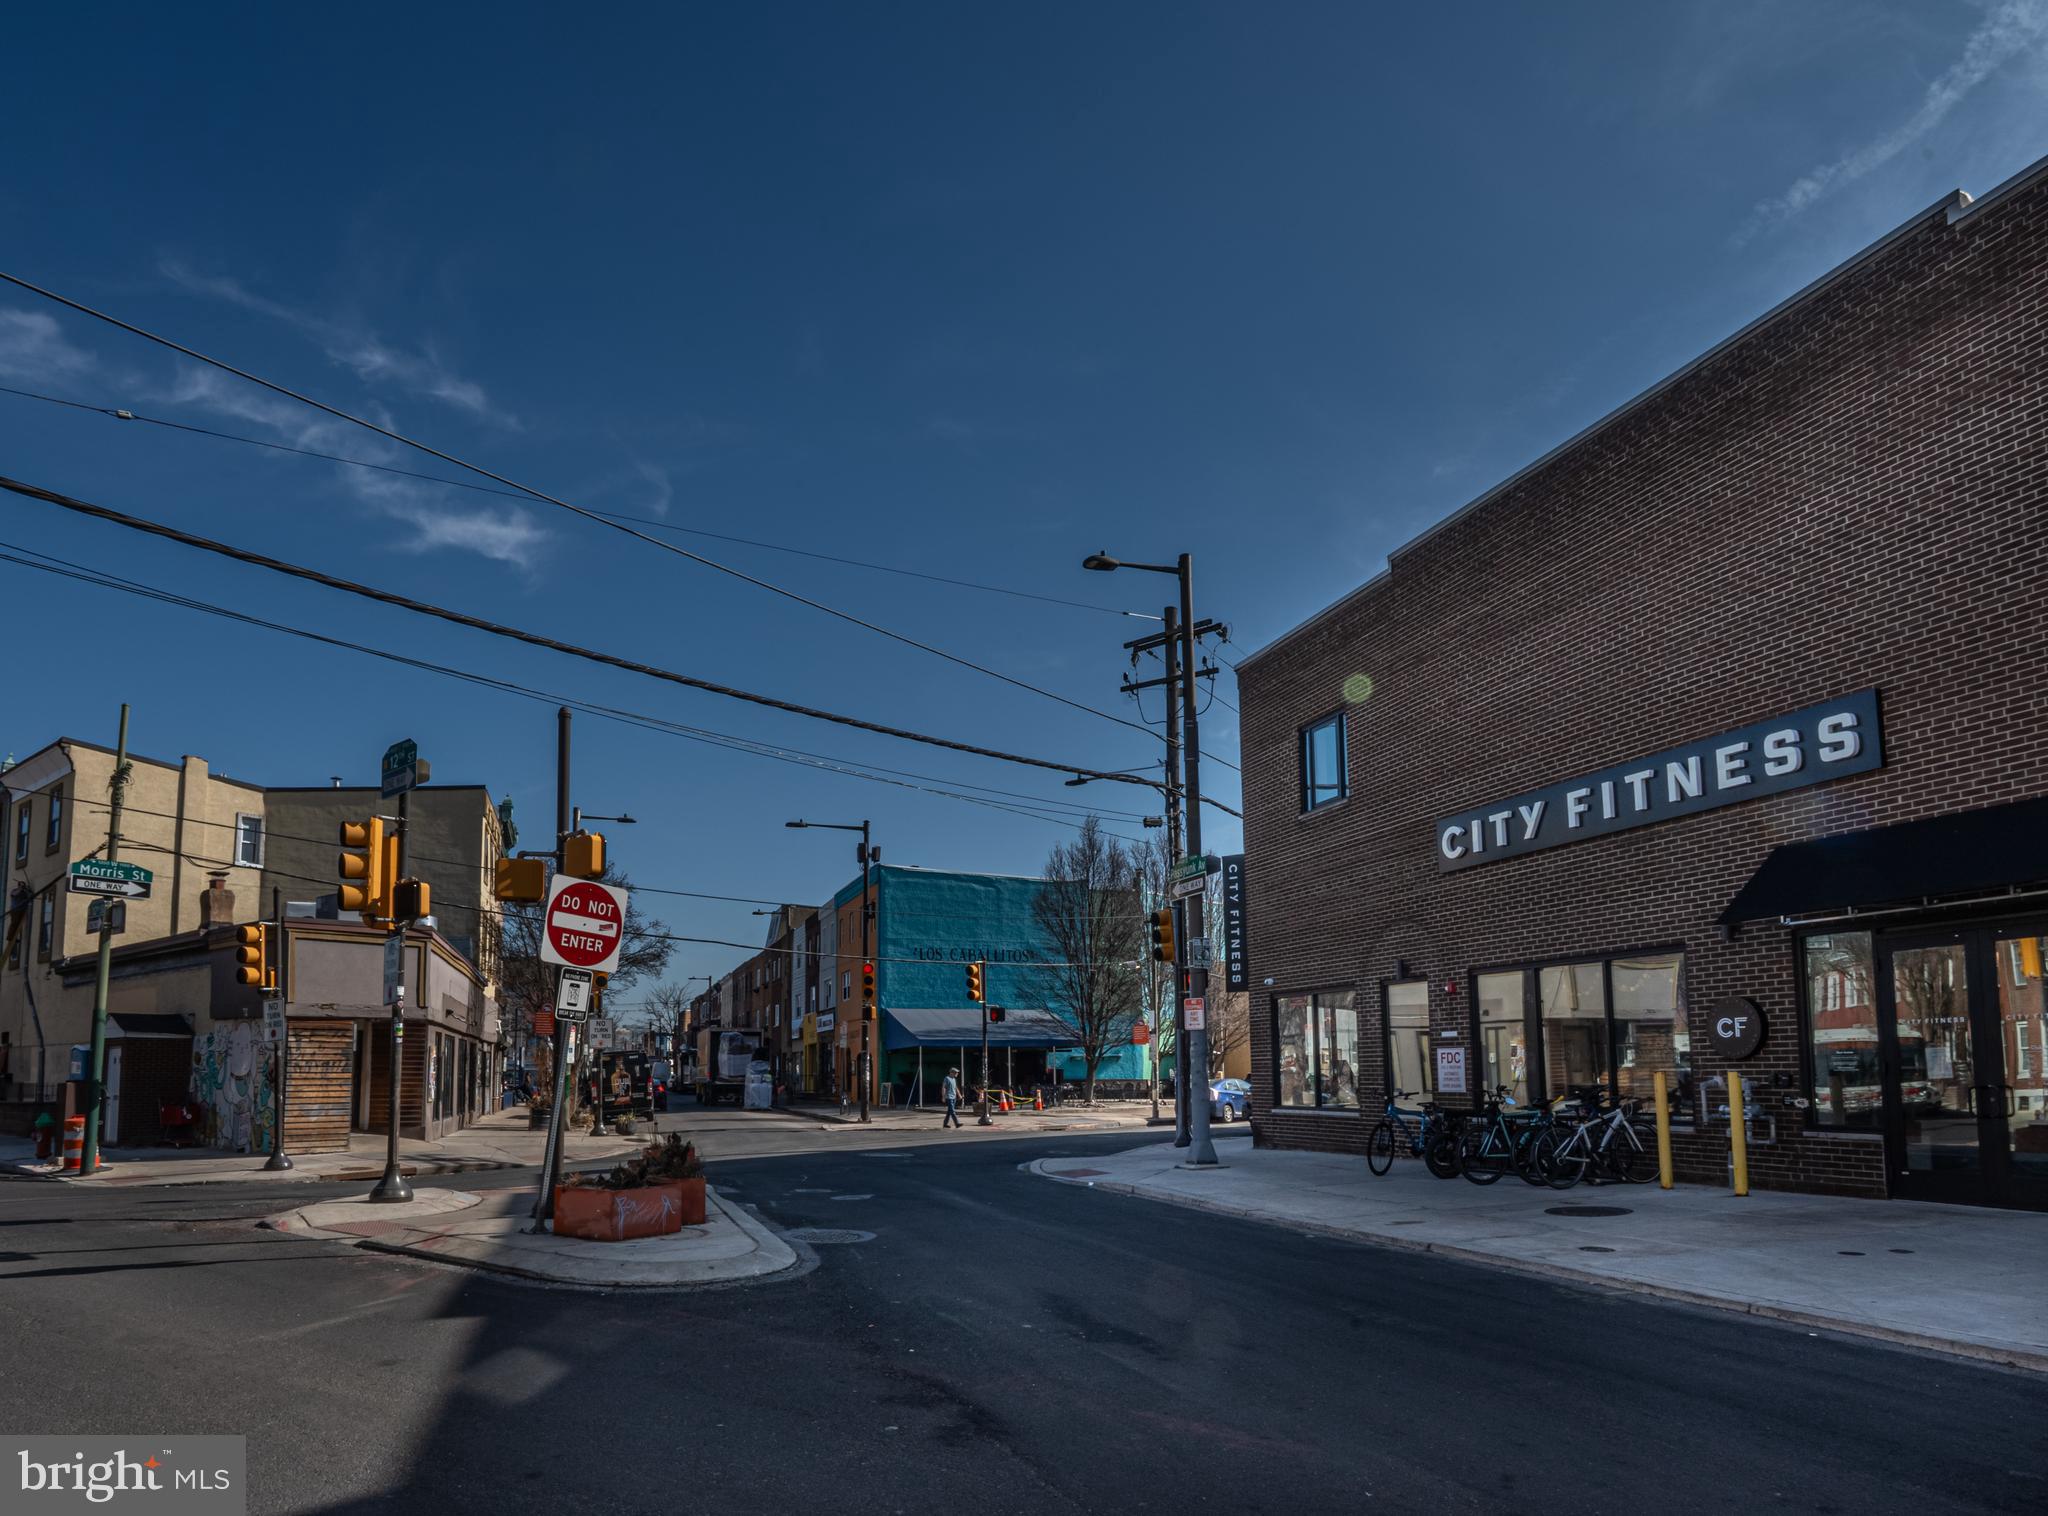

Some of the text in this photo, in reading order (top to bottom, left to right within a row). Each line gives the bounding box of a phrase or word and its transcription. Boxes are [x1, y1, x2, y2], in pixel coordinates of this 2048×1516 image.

[1442, 711, 1861, 860] CITY FITNESS
[80, 864, 145, 881] Morris St
[84, 880, 101, 889] ONE
[1191, 879, 1201, 887] WAY
[561, 895, 614, 917] DO NOT
[1228, 864, 1241, 983] CITY FITNESS
[560, 933, 604, 953] ENTER
[268, 1002, 278, 1010] NO
[1716, 1016, 1748, 1038] CF
[1924, 1016, 1965, 1024] FITNESS
[1440, 1052, 1461, 1064] FDC
